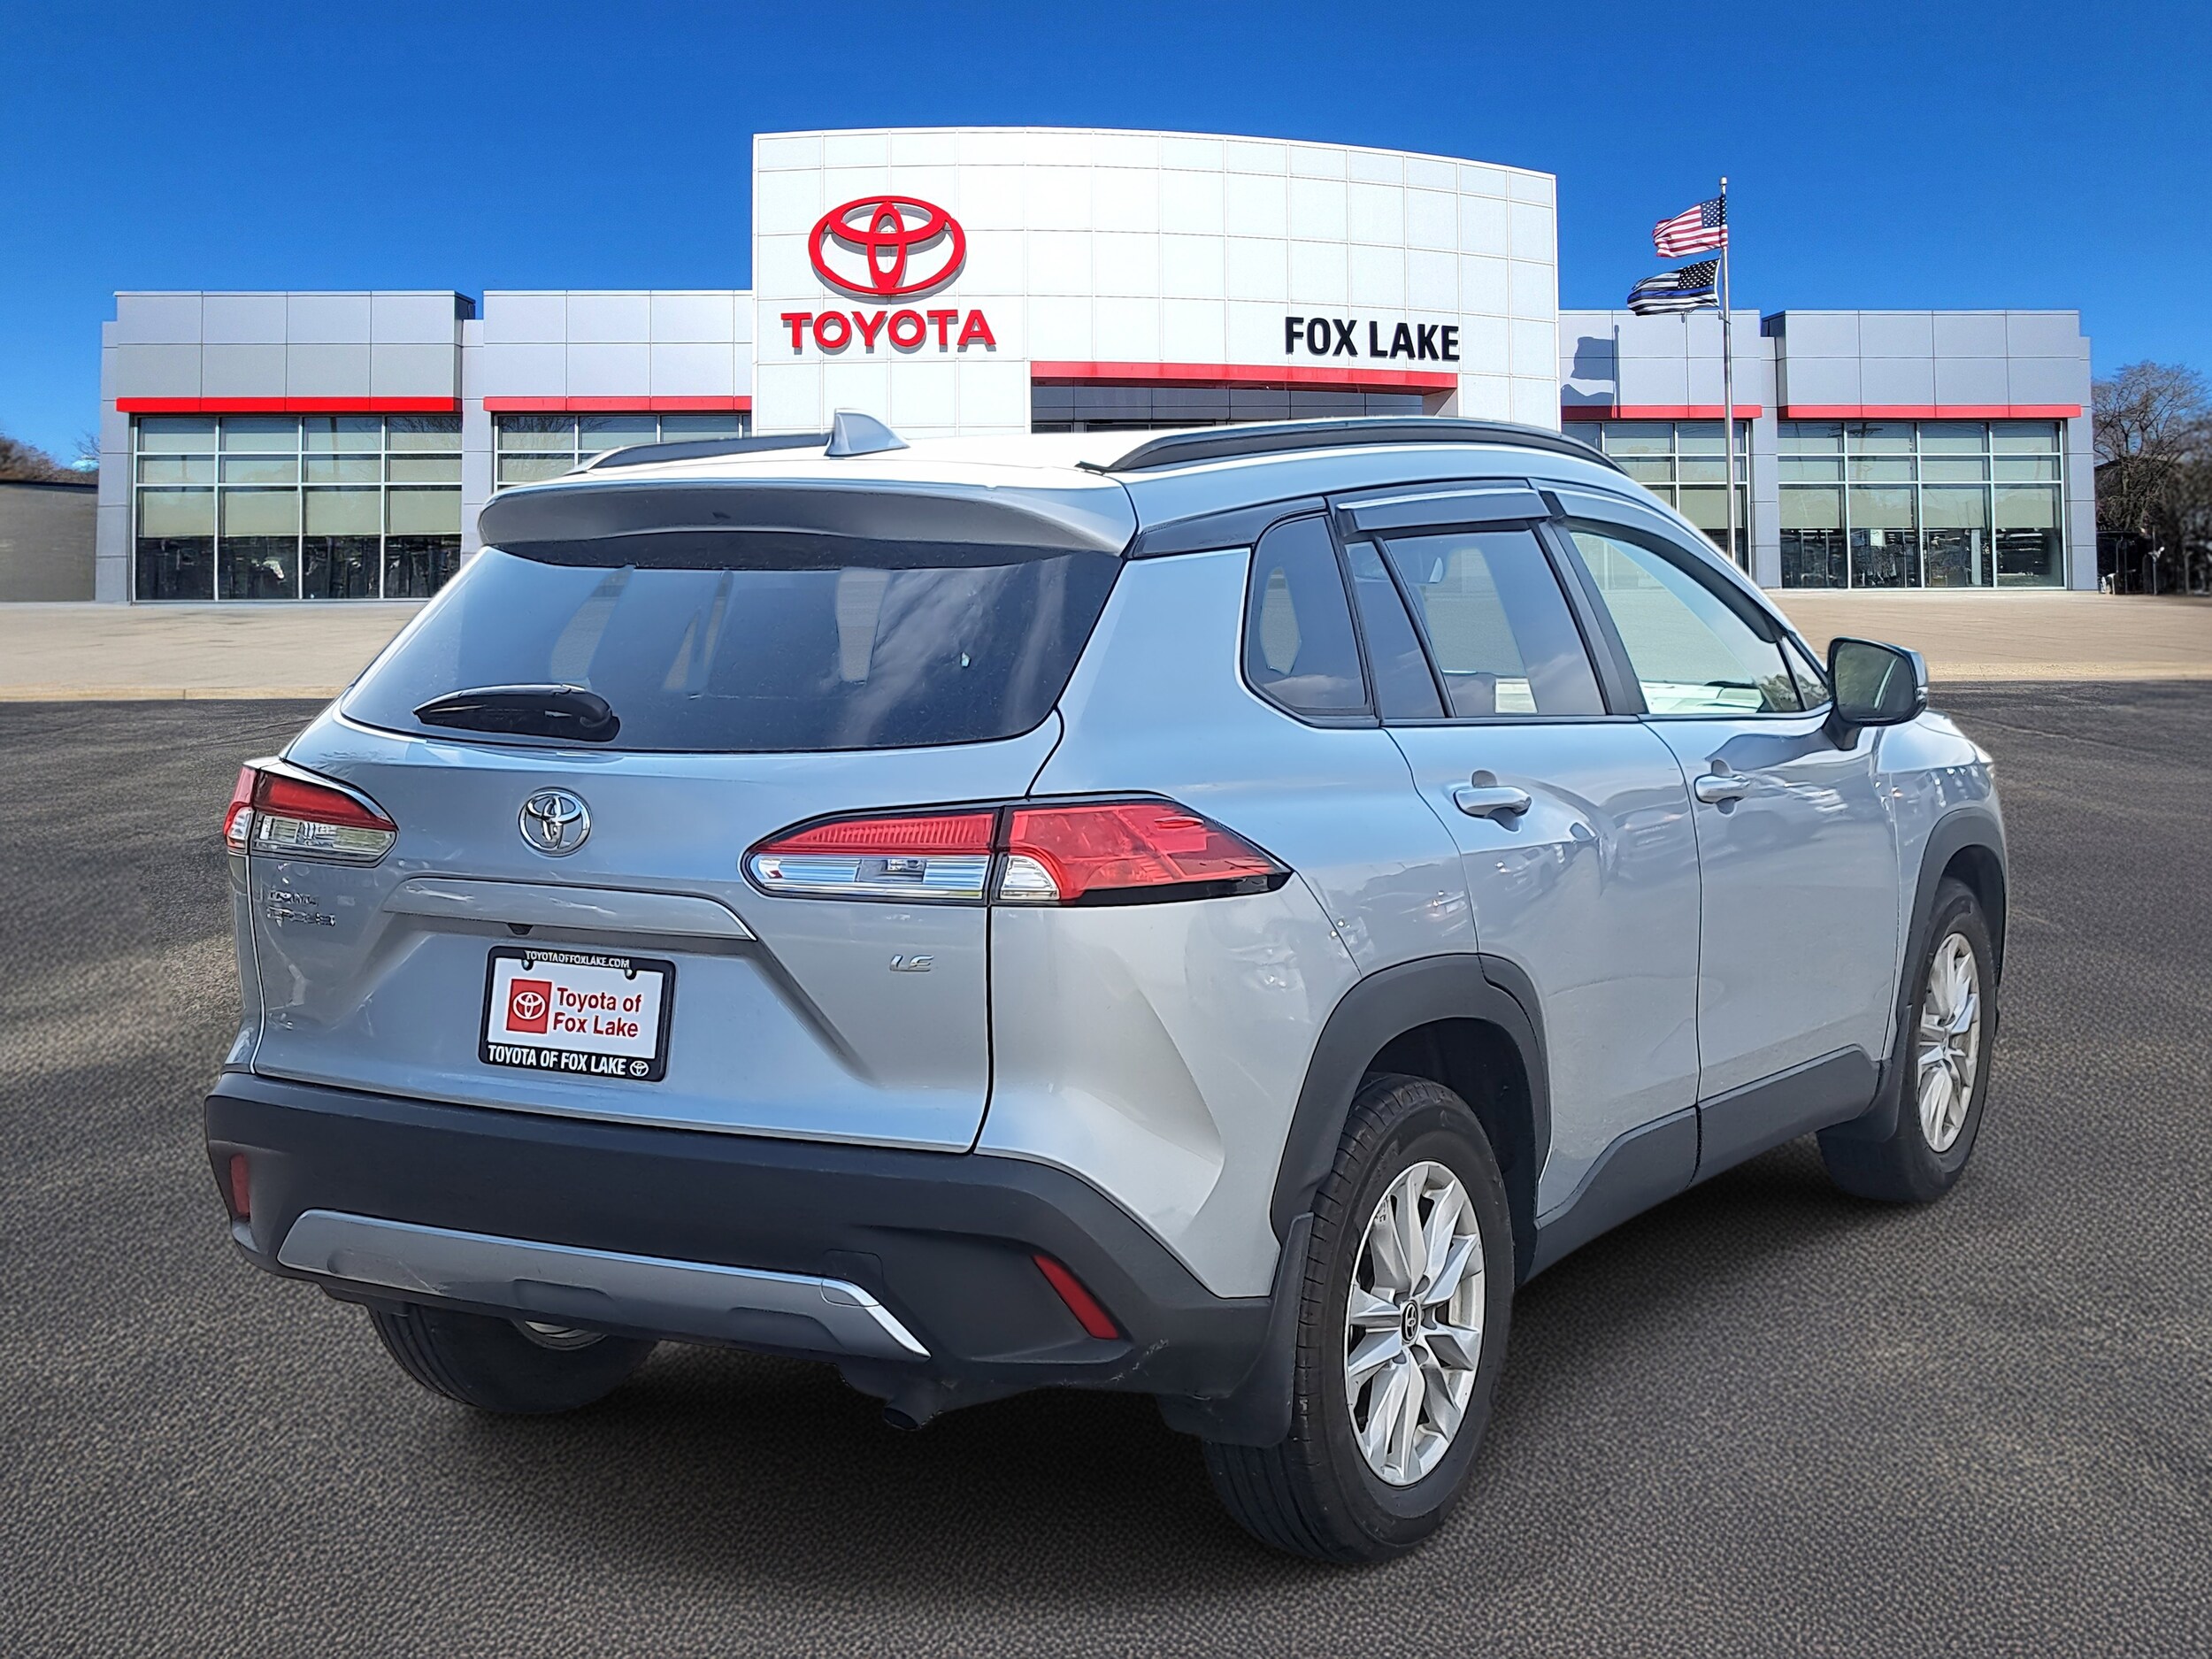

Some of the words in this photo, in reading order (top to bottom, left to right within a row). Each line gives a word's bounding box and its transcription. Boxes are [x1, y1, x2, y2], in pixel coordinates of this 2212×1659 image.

[780, 310, 997, 349] TOYOTA
[1285, 316, 1358, 357] FOX
[1369, 320, 1460, 361] LAKE
[524, 949, 631, 970] TOYOTAOFFOXLAKE.COM
[889, 954, 934, 972] LE
[557, 987, 617, 1013] Toyota
[622, 994, 642, 1013] of
[552, 1012, 588, 1033] Fox
[593, 1015, 639, 1038] Lake
[488, 1044, 537, 1067] TOYOTA
[540, 1049, 559, 1068] OF
[560, 1052, 588, 1071] FOX
[590, 1055, 627, 1076] LAKE
